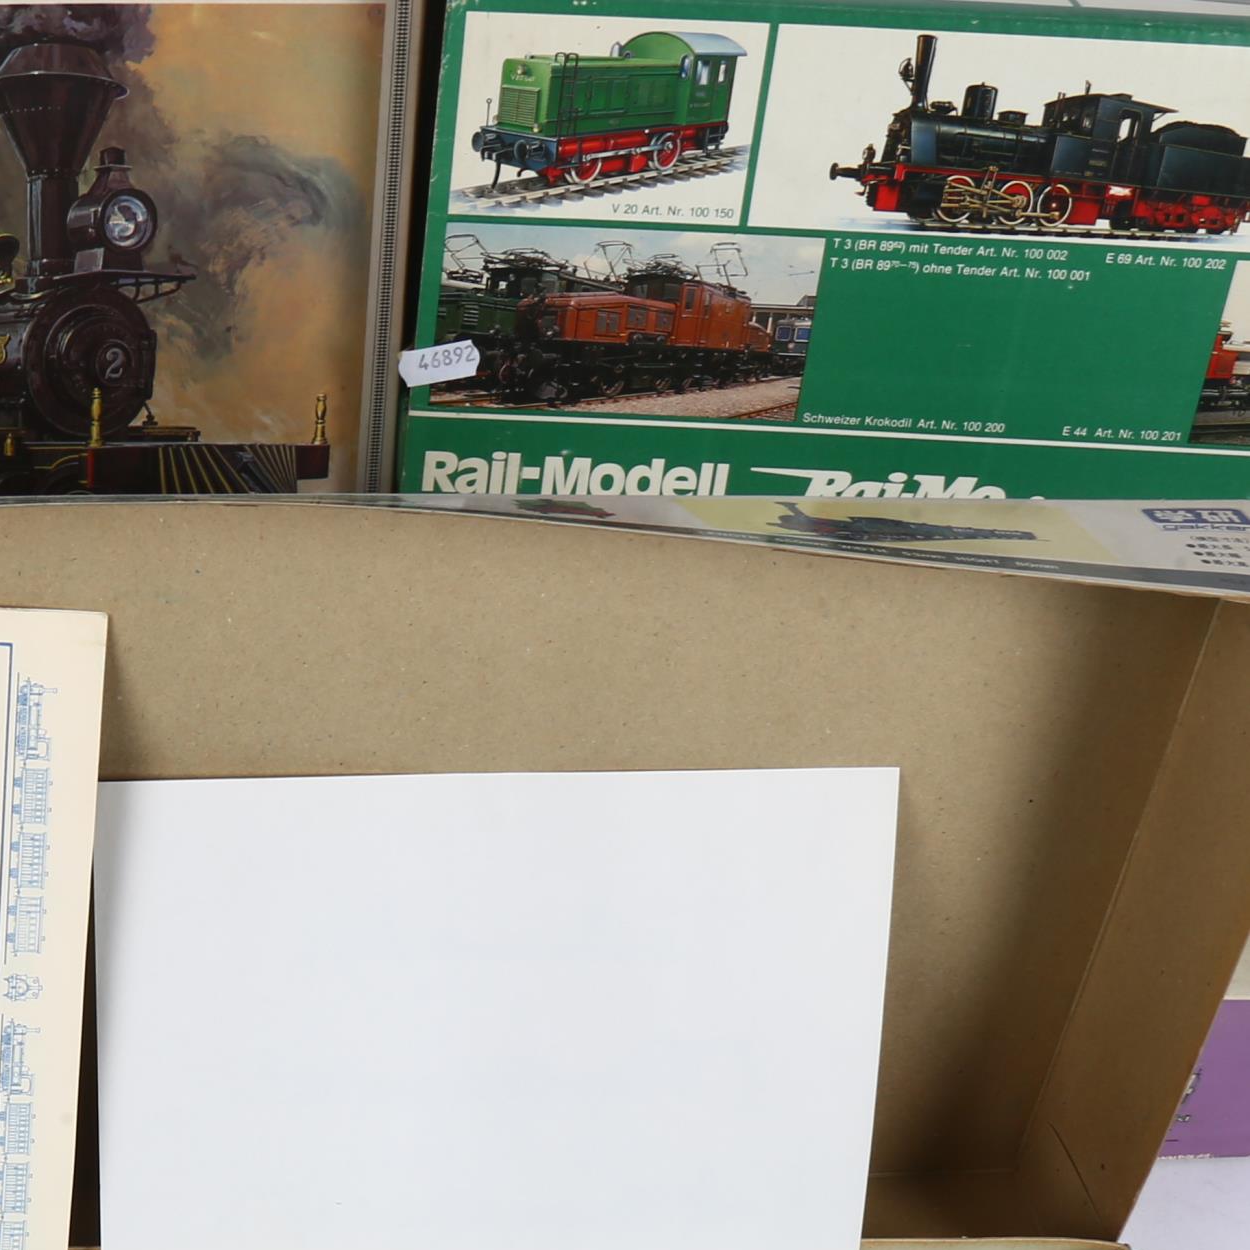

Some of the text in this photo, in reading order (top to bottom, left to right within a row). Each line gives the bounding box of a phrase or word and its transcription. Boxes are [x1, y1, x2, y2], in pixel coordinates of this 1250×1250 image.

[612, 203, 734, 218] V 20 Art. Nr. 100 150
[833, 238, 842, 249] T
[843, 239, 851, 249] 3
[854, 239, 877, 252] (BR
[909, 243, 929, 254] mit
[933, 243, 973, 256] Tender
[976, 246, 997, 257] Art.
[1001, 247, 1019, 258] Nr.
[1024, 248, 1043, 260] 100
[1047, 249, 1068, 261] 002
[1105, 252, 1227, 270] E 69 Art. Nr. 100 202
[830, 257, 839, 268] T
[840, 258, 849, 269] 3
[851, 258, 873, 271] (BR
[922, 263, 952, 274] ohne
[956, 264, 996, 277] Tender
[999, 266, 1020, 278] Art.
[1024, 267, 1042, 279] Nr.
[1047, 269, 1067, 280] 100
[1069, 270, 1090, 281] 001
[104, 348, 125, 380] 2
[419, 344, 476, 370] 46892
[802, 412, 1006, 433] Schweizer Krokodil Art. Nr. 100 200
[1062, 426, 1182, 441] E 44 Art. Nr. 100 201
[421, 450, 730, 497] Rail-Modell
